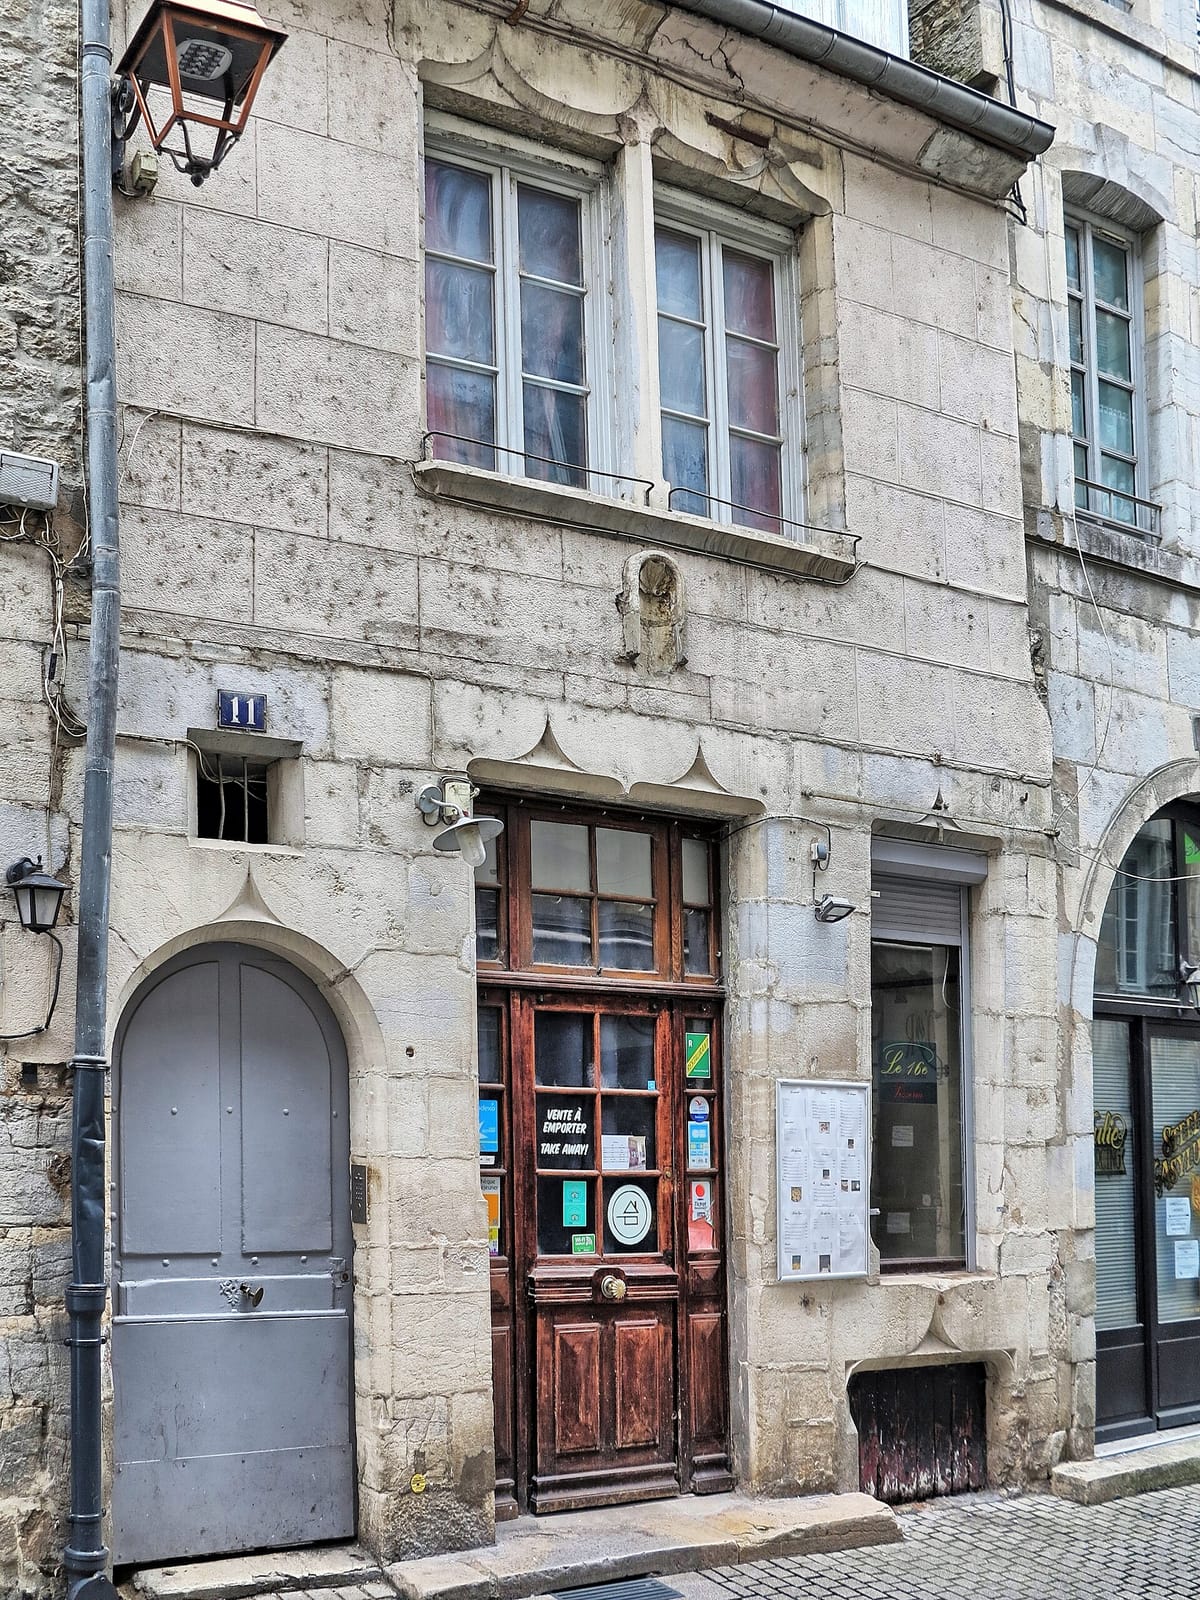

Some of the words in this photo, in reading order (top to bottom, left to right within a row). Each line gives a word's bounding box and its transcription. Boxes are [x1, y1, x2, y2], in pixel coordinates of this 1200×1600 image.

[230, 696, 256, 725] 11
[547, 1109, 573, 1121] VENTE
[574, 1107, 582, 1122] À
[542, 1122, 587, 1135] EMPORTER
[540, 1143, 561, 1155] TAKE
[561, 1143, 589, 1156] AWAY!
